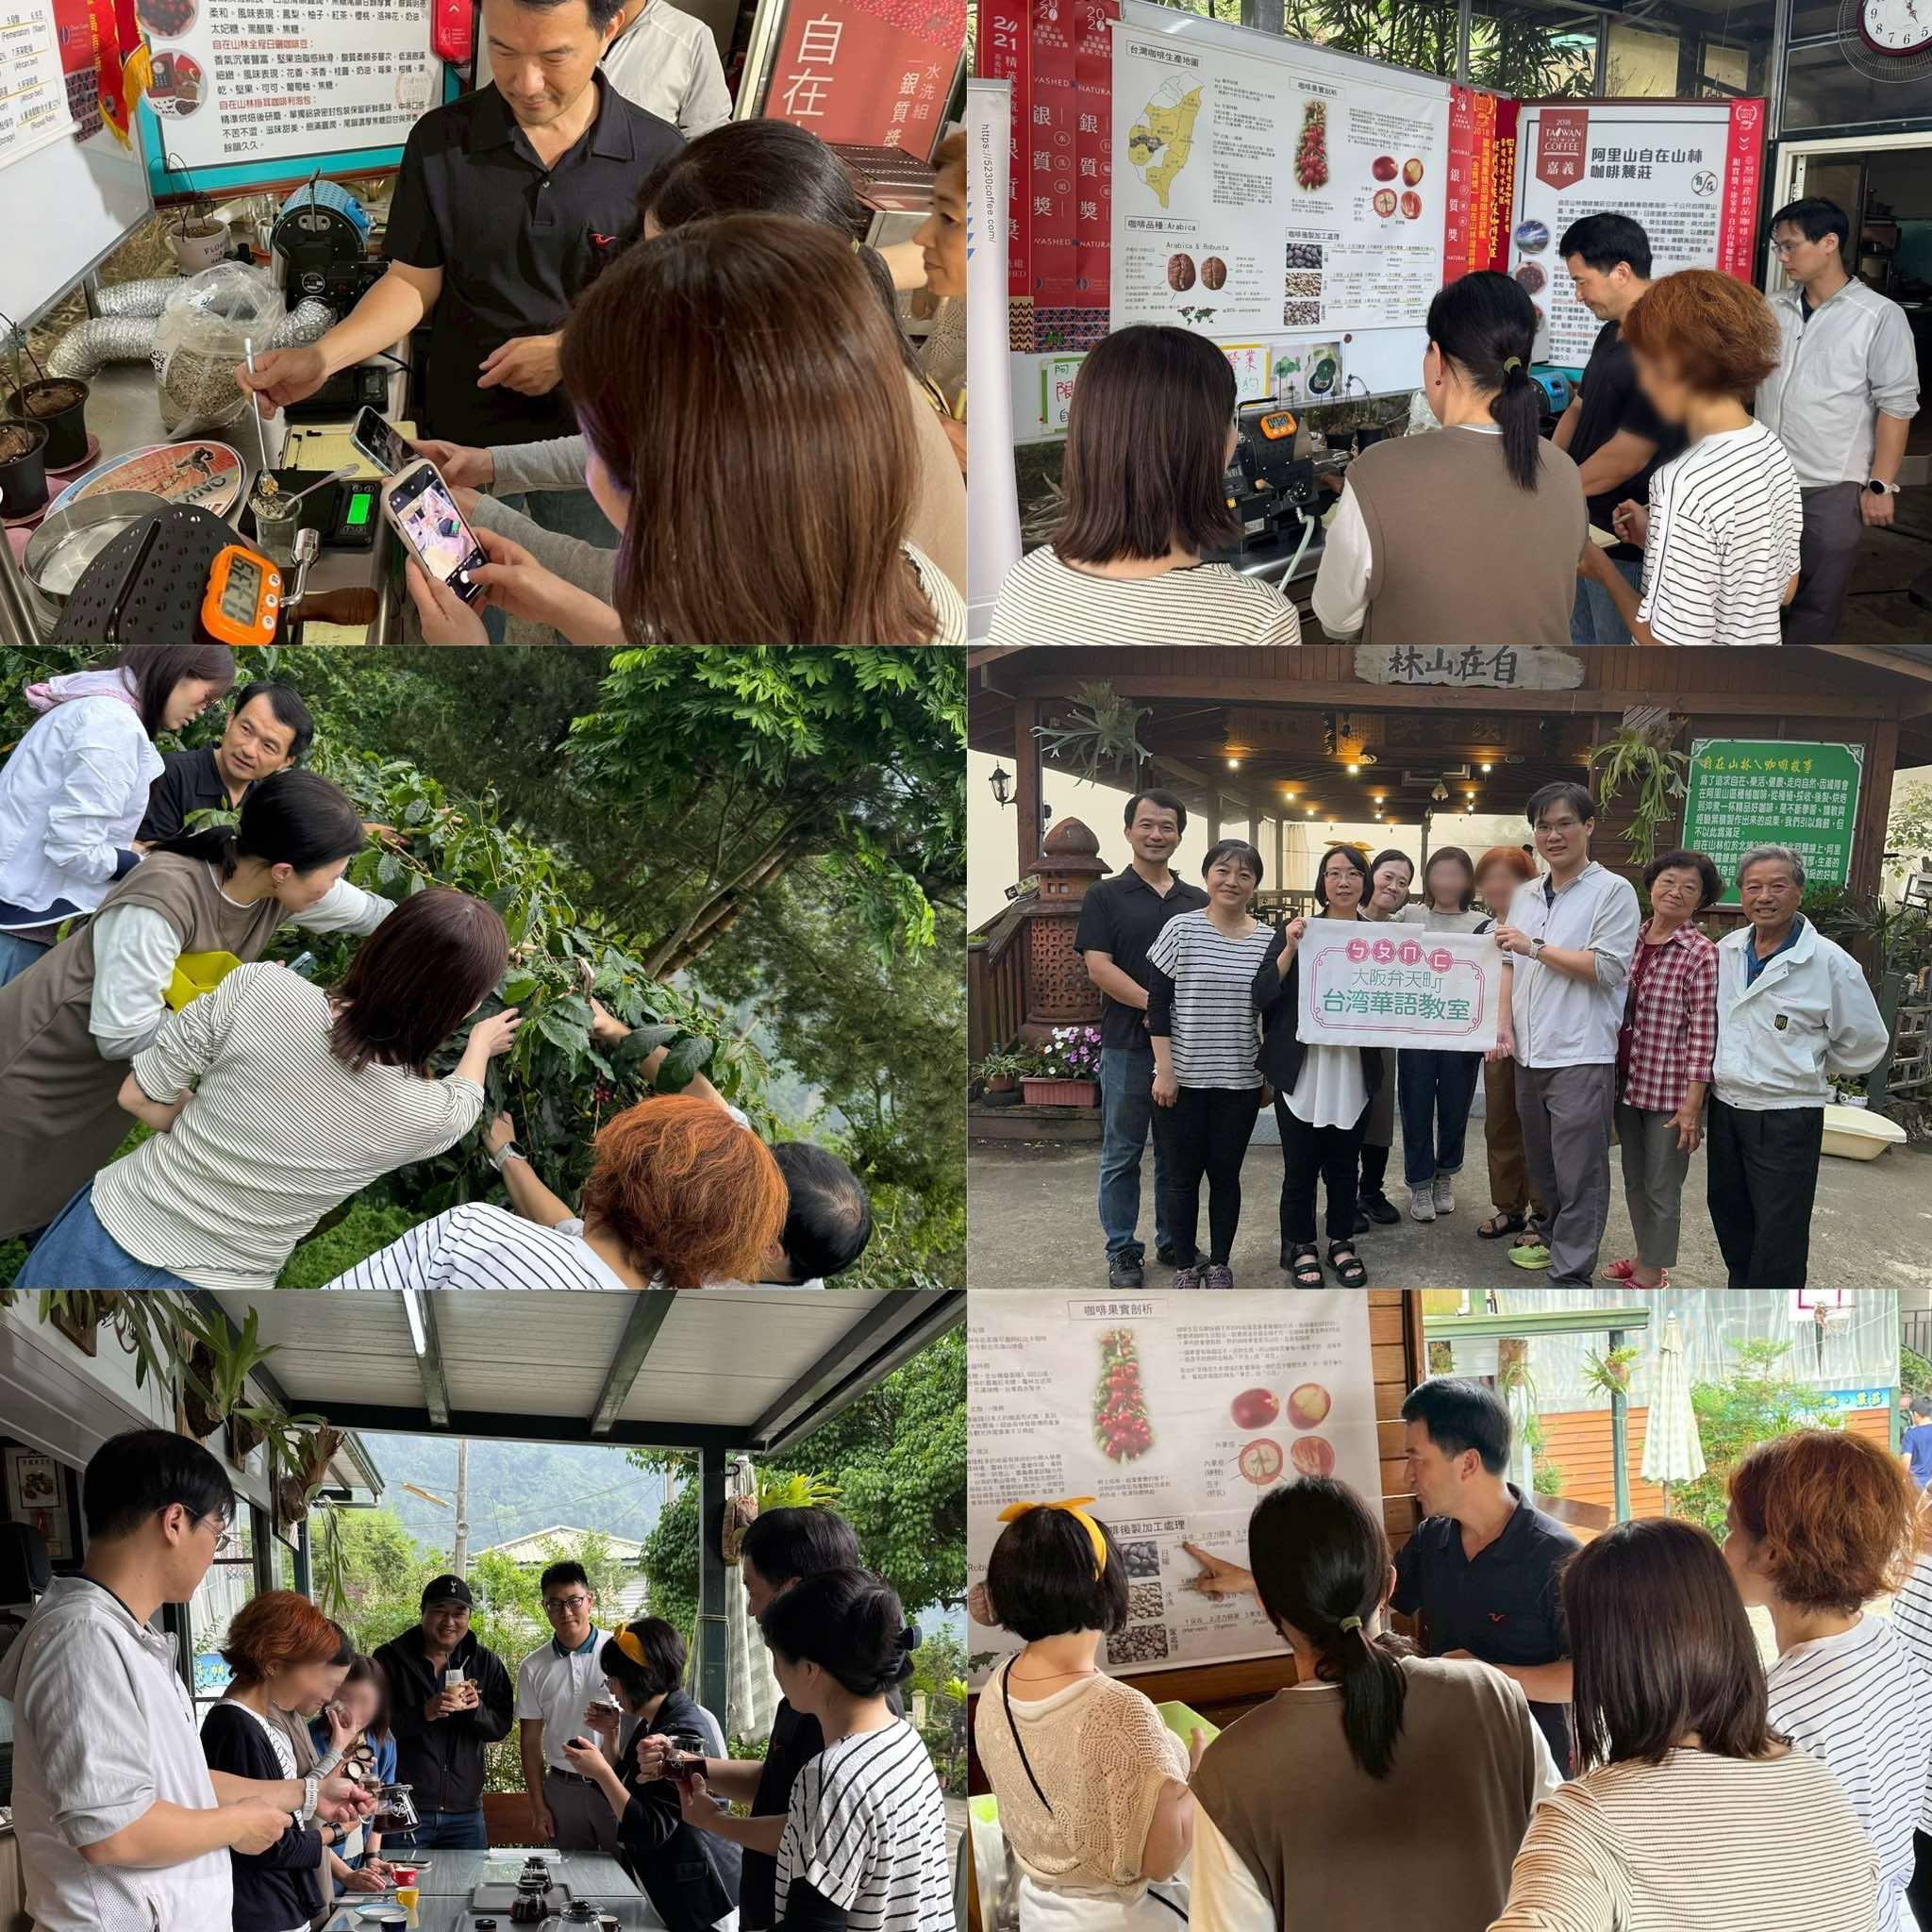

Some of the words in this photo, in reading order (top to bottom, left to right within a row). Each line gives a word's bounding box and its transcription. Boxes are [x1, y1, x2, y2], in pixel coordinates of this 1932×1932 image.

[1871, 8, 1877, 19] 9
[1875, 23, 1883, 35] 8
[1922, 25, 1931, 37] 5
[1888, 32, 1895, 43] 7
[1903, 33, 1910, 44] 6
[1129, 44, 1200, 68] 台灣咖啡生產地圖
[782, 13, 843, 135] 自在
[912, 60, 942, 121] 水洗組
[1078, 84, 1112, 95] NATURA
[1544, 142, 1580, 152] COFFEE
[1591, 147, 1704, 164] 阿里山自在山林
[1079, 112, 1099, 221] 銀質獎
[1546, 160, 1575, 175] 嘉義
[981, 124, 997, 243] https://5230coffee.com/
[1079, 241, 1111, 249] NATURA
[1351, 969, 1444, 994] 大阪弁天町
[1323, 988, 1471, 1021] 台湾華語教室
[1083, 1303, 1154, 1317] 咖啡果實剖析
[1108, 1519, 1186, 1538] 啡後製加工處理
